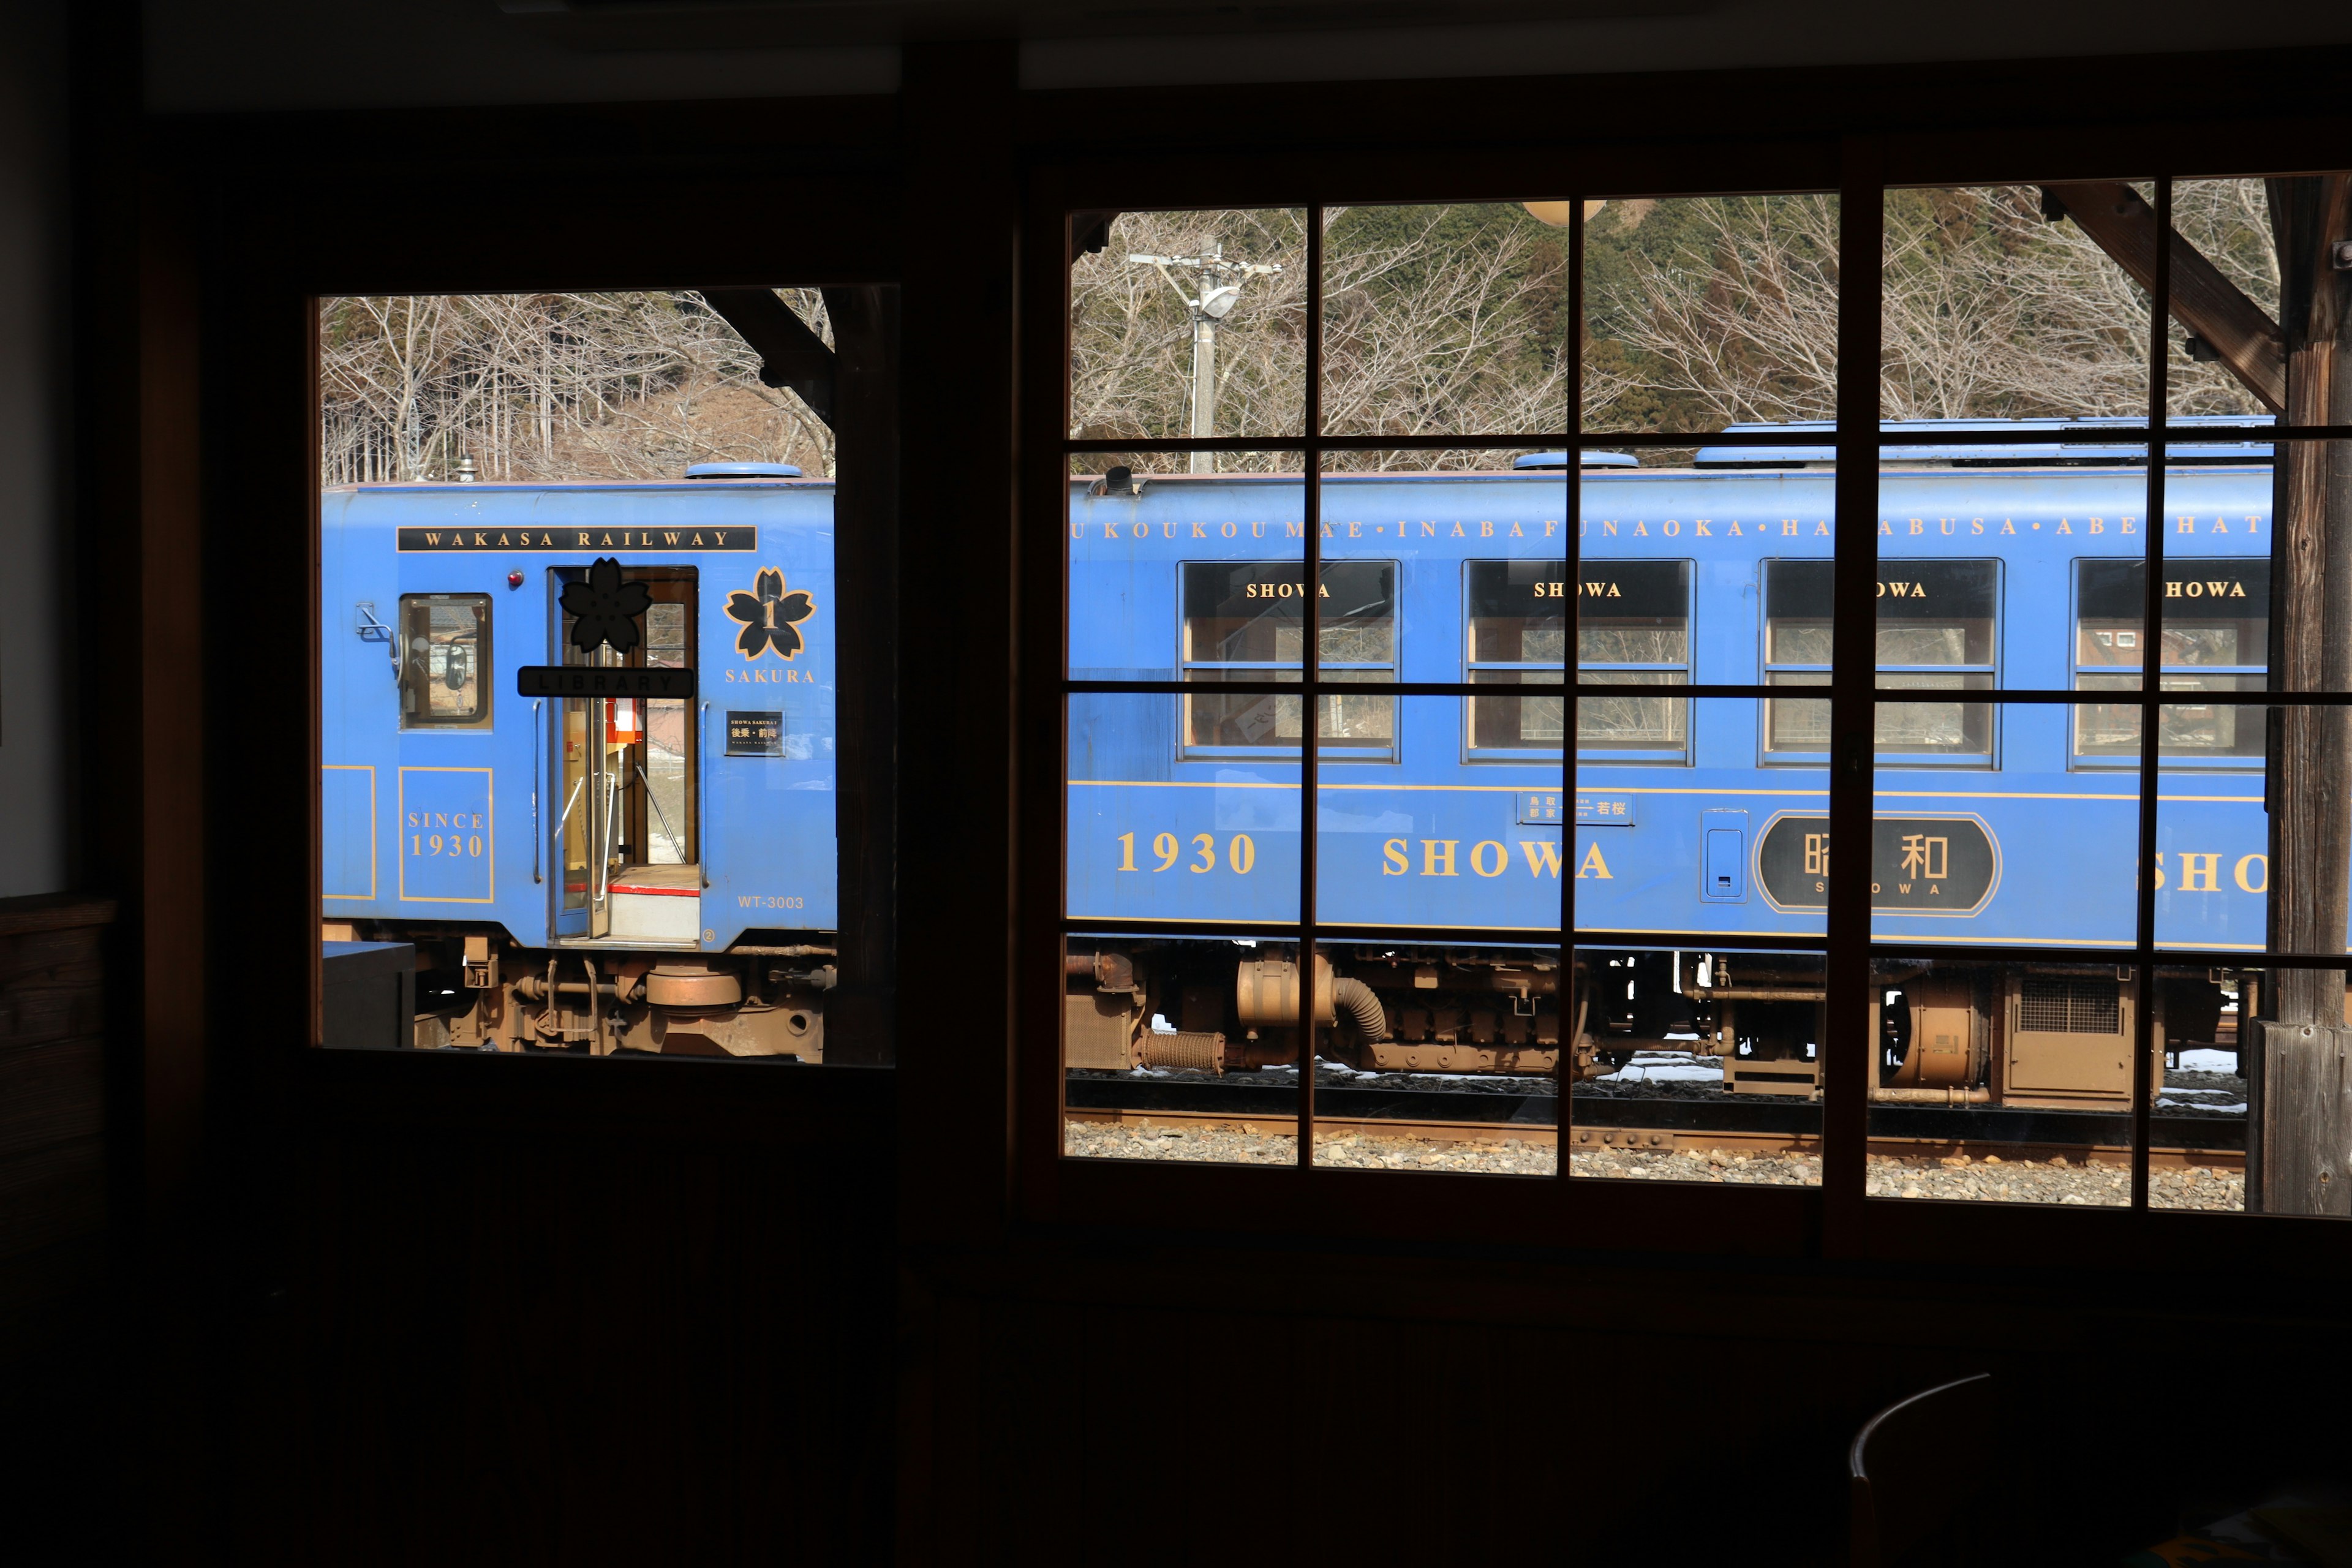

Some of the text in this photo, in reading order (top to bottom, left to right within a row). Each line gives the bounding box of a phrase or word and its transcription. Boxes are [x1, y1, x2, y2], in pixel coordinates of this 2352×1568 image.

[1781, 518, 2016, 536] HAABUSA
[2056, 516, 2137, 535] ABE
[425, 532, 728, 546] WAKASA RAILWAY
[763, 600, 778, 629] 1
[538, 674, 672, 692] LIBRARY
[725, 669, 815, 683] SAKURA
[1597, 801, 1626, 815] 若桜
[408, 812, 484, 829] SINCE
[411, 834, 483, 858] 1930
[1117, 831, 1256, 875] 1930
[1382, 838, 1614, 880] SHOWA
[1815, 881, 1940, 895] SOWA
[737, 894, 805, 910] WT-3003
